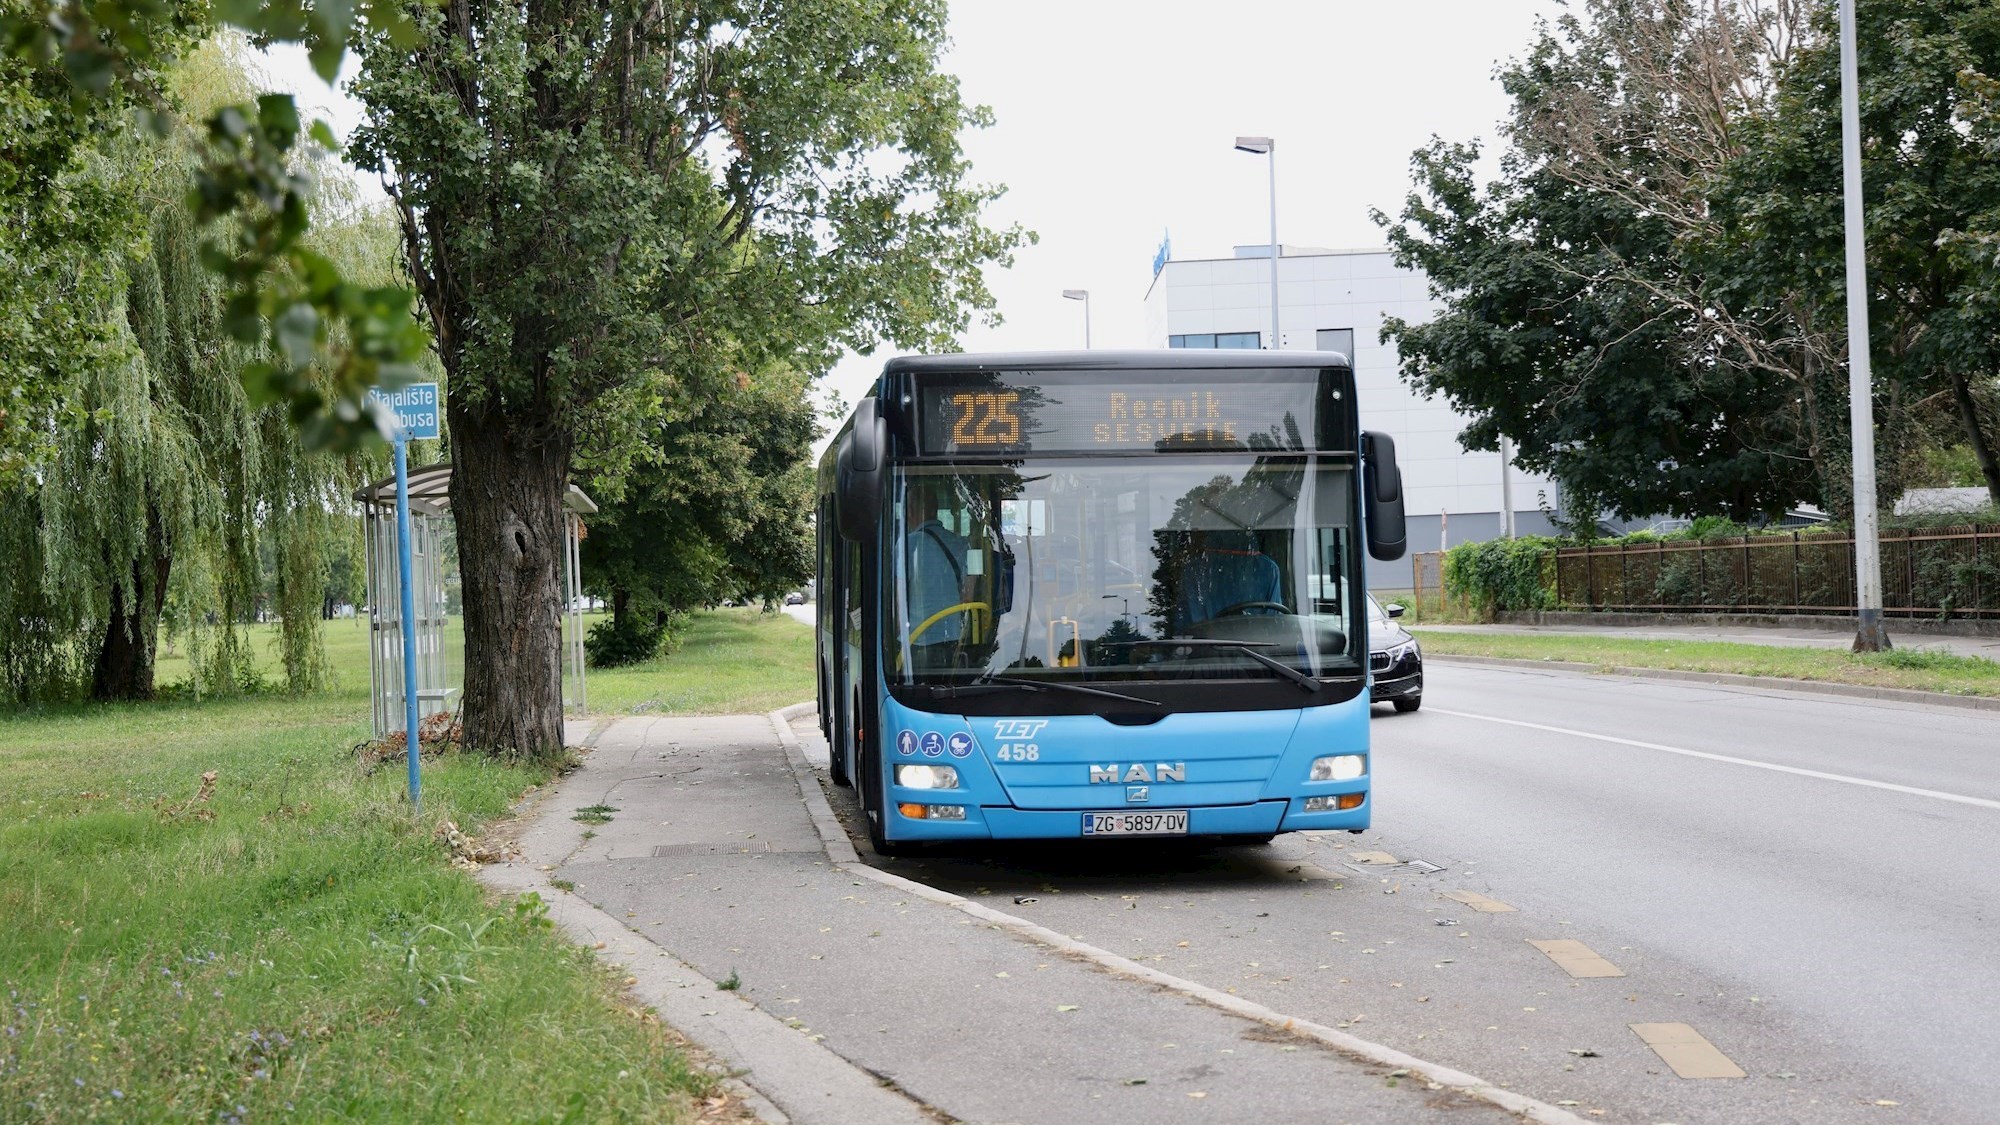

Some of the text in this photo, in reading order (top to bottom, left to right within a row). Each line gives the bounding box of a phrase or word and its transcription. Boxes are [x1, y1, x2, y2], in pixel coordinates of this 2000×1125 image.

[367, 388, 433, 411] Stajalište
[1111, 392, 1220, 419] Resnik
[953, 393, 1019, 444] 225
[1094, 422, 1237, 442] SESVETE
[994, 719, 1049, 740] ZET
[997, 743, 1039, 761] 458
[1089, 762, 1185, 784] MAN
[1095, 816, 1114, 832] ZG
